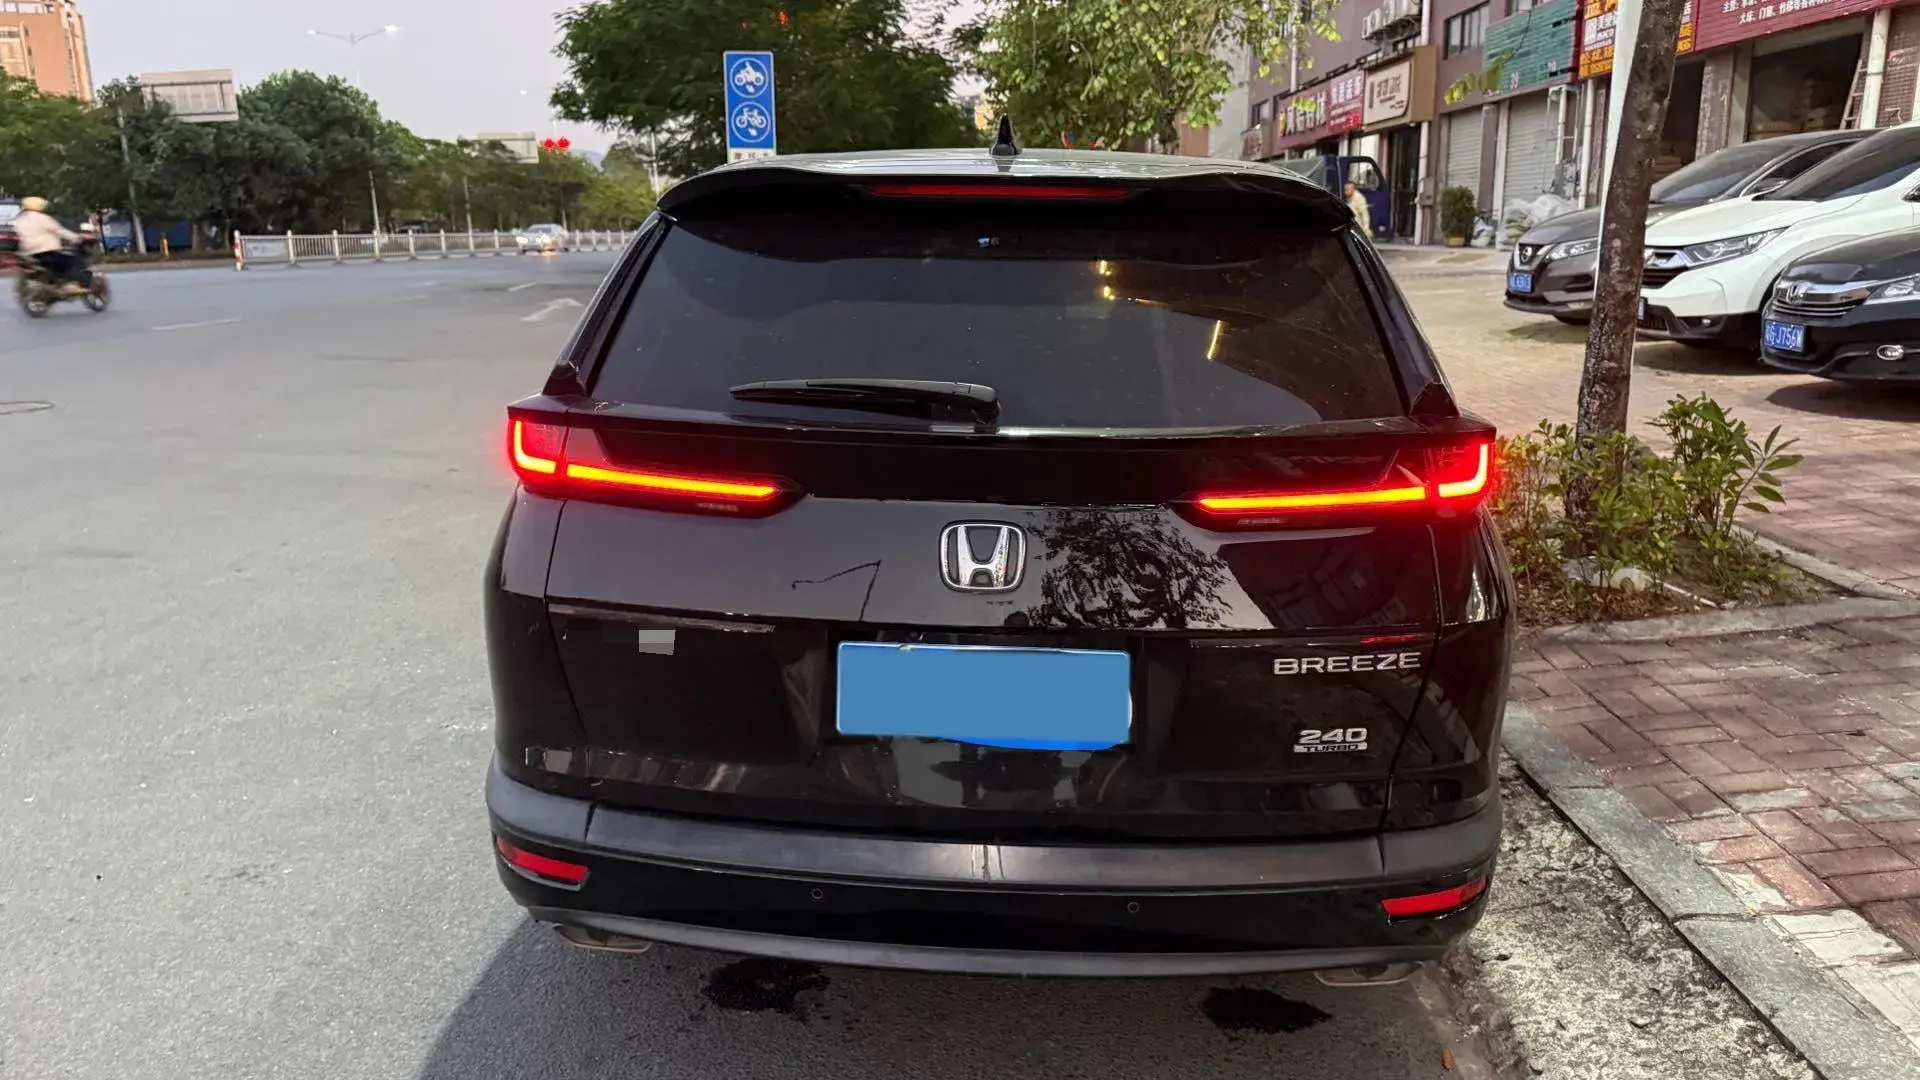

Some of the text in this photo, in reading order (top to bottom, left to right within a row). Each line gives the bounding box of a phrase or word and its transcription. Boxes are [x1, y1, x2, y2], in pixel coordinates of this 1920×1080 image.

[1273, 651, 1421, 675] BREEZE
[1298, 727, 1368, 744] 240
[1302, 743, 1361, 752] TURBO
